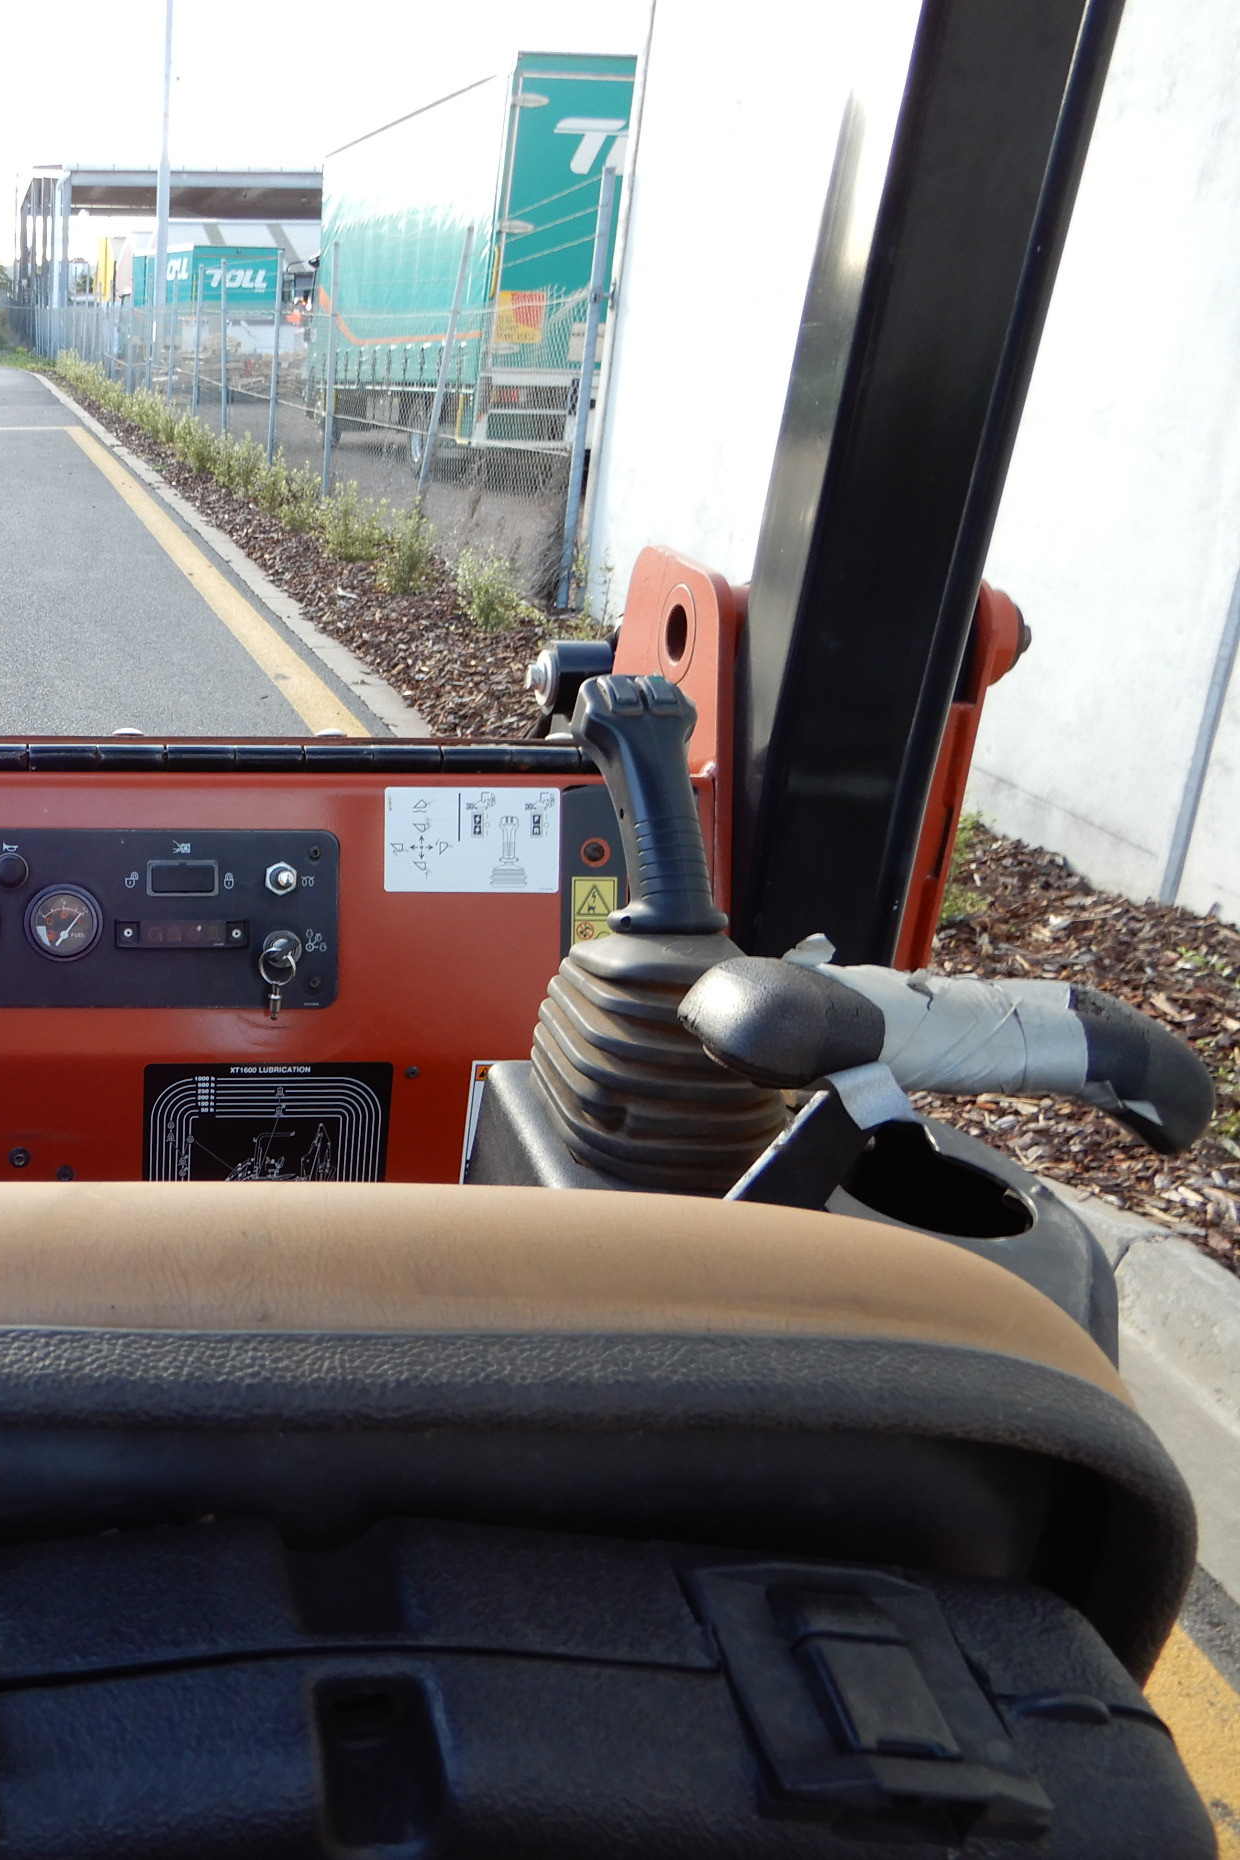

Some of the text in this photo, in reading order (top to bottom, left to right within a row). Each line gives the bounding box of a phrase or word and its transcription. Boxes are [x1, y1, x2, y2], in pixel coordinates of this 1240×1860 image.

[166, 257, 189, 281] OLL
[205, 268, 267, 289] TOLL
[230, 1066, 257, 1074] XT1600
